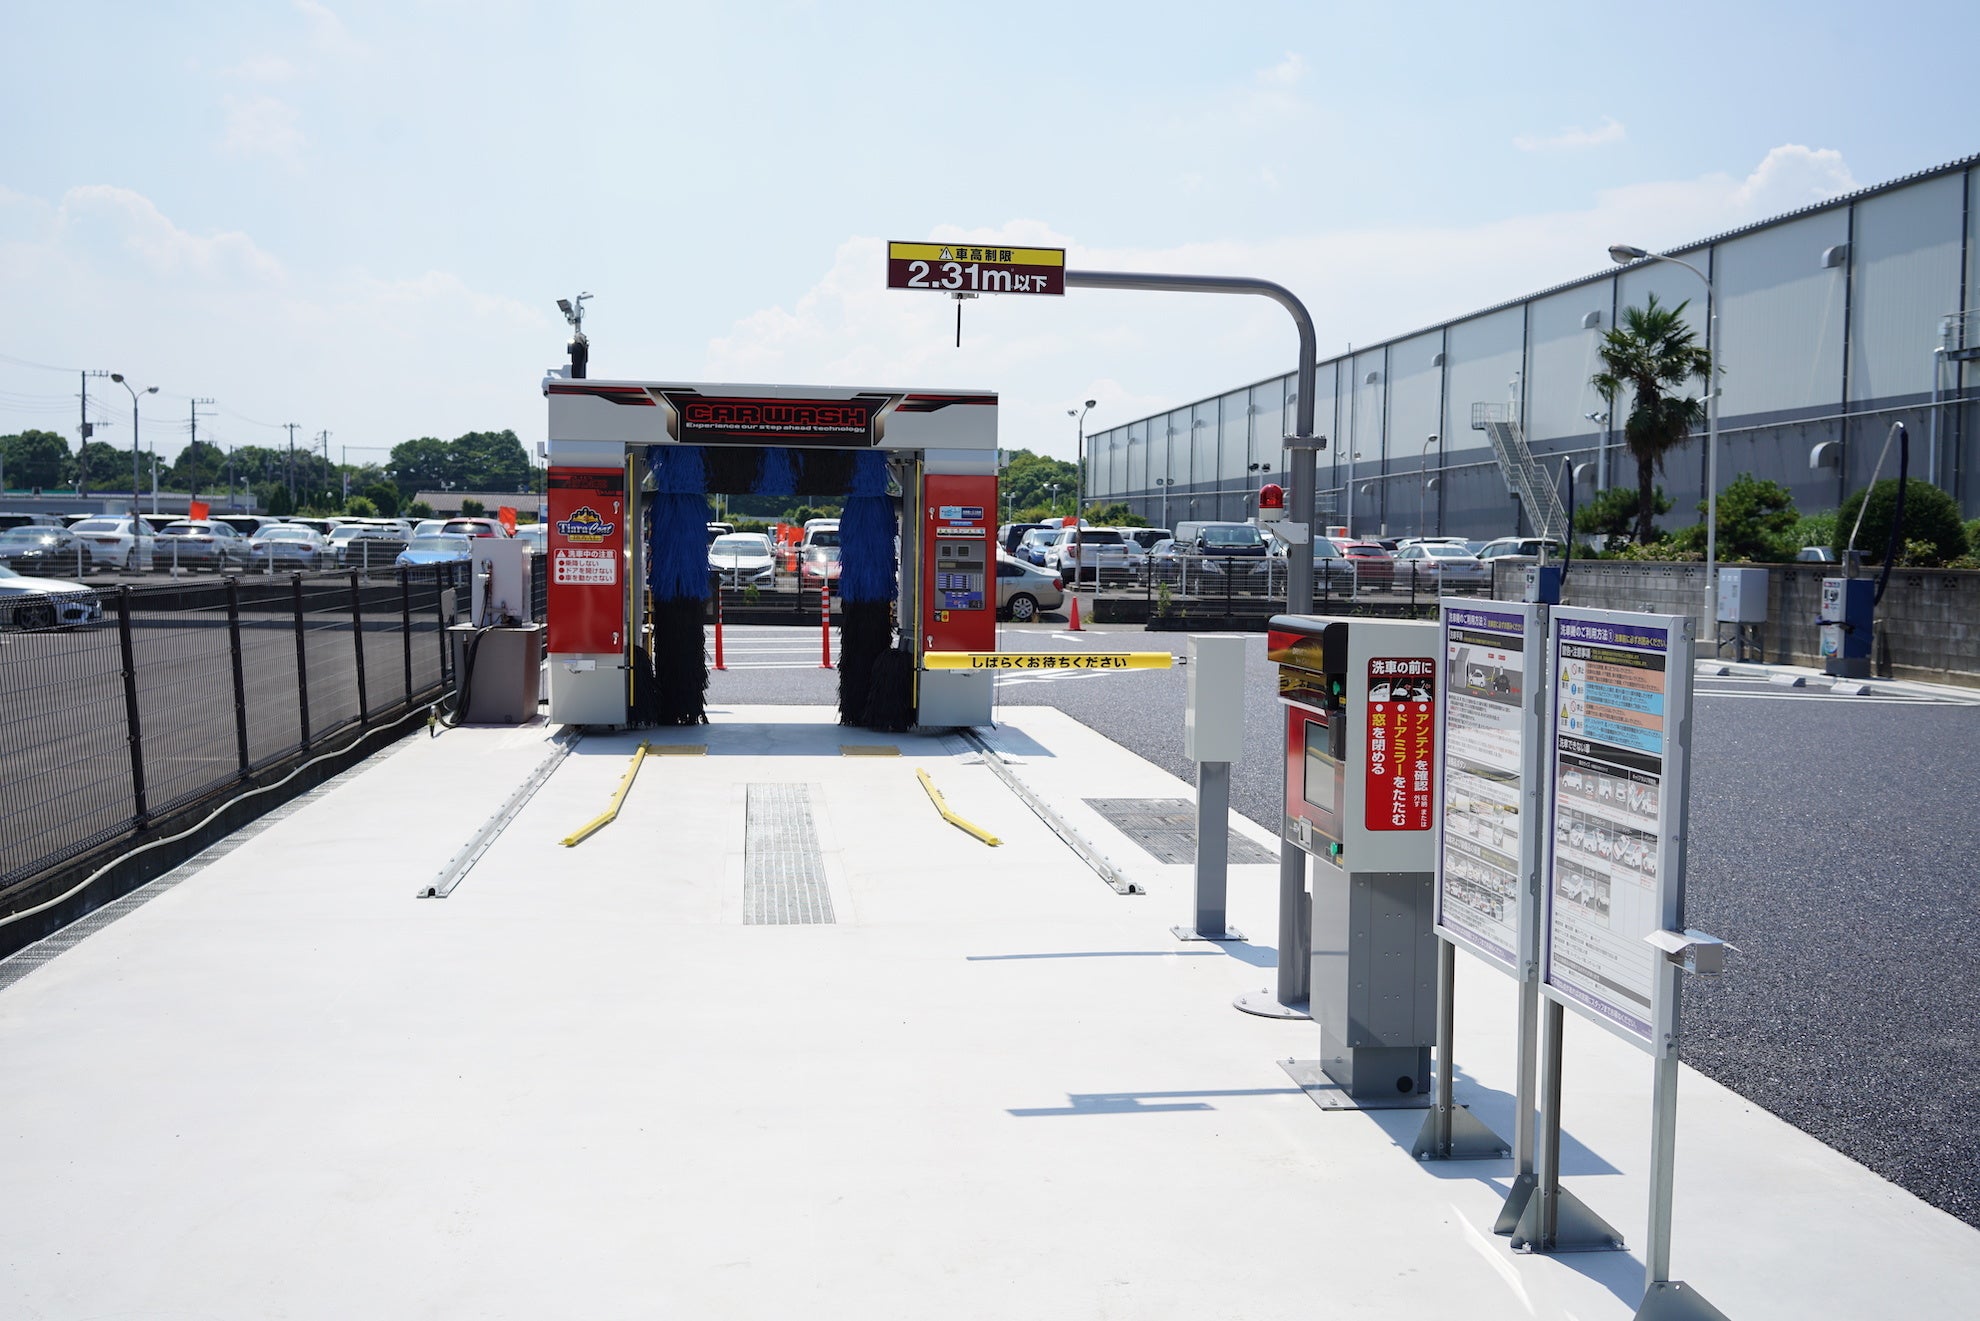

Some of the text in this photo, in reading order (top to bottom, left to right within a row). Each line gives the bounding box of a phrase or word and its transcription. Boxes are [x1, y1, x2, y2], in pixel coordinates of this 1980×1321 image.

[955, 248, 1012, 262] 車高制限
[907, 260, 1048, 293] 2.31m以下
[685, 404, 867, 426] CAR WASH
[813, 425, 866, 433] technology
[559, 522, 614, 535] Tiara Coat
[971, 656, 1127, 669] しばらくお待ちください
[1371, 660, 1433, 675] 洗車の前に
[1371, 713, 1387, 775] 窓を閉める
[1413, 713, 1430, 792] アンテナを確認
[1391, 713, 1408, 827] ドアミラーをたたむ
